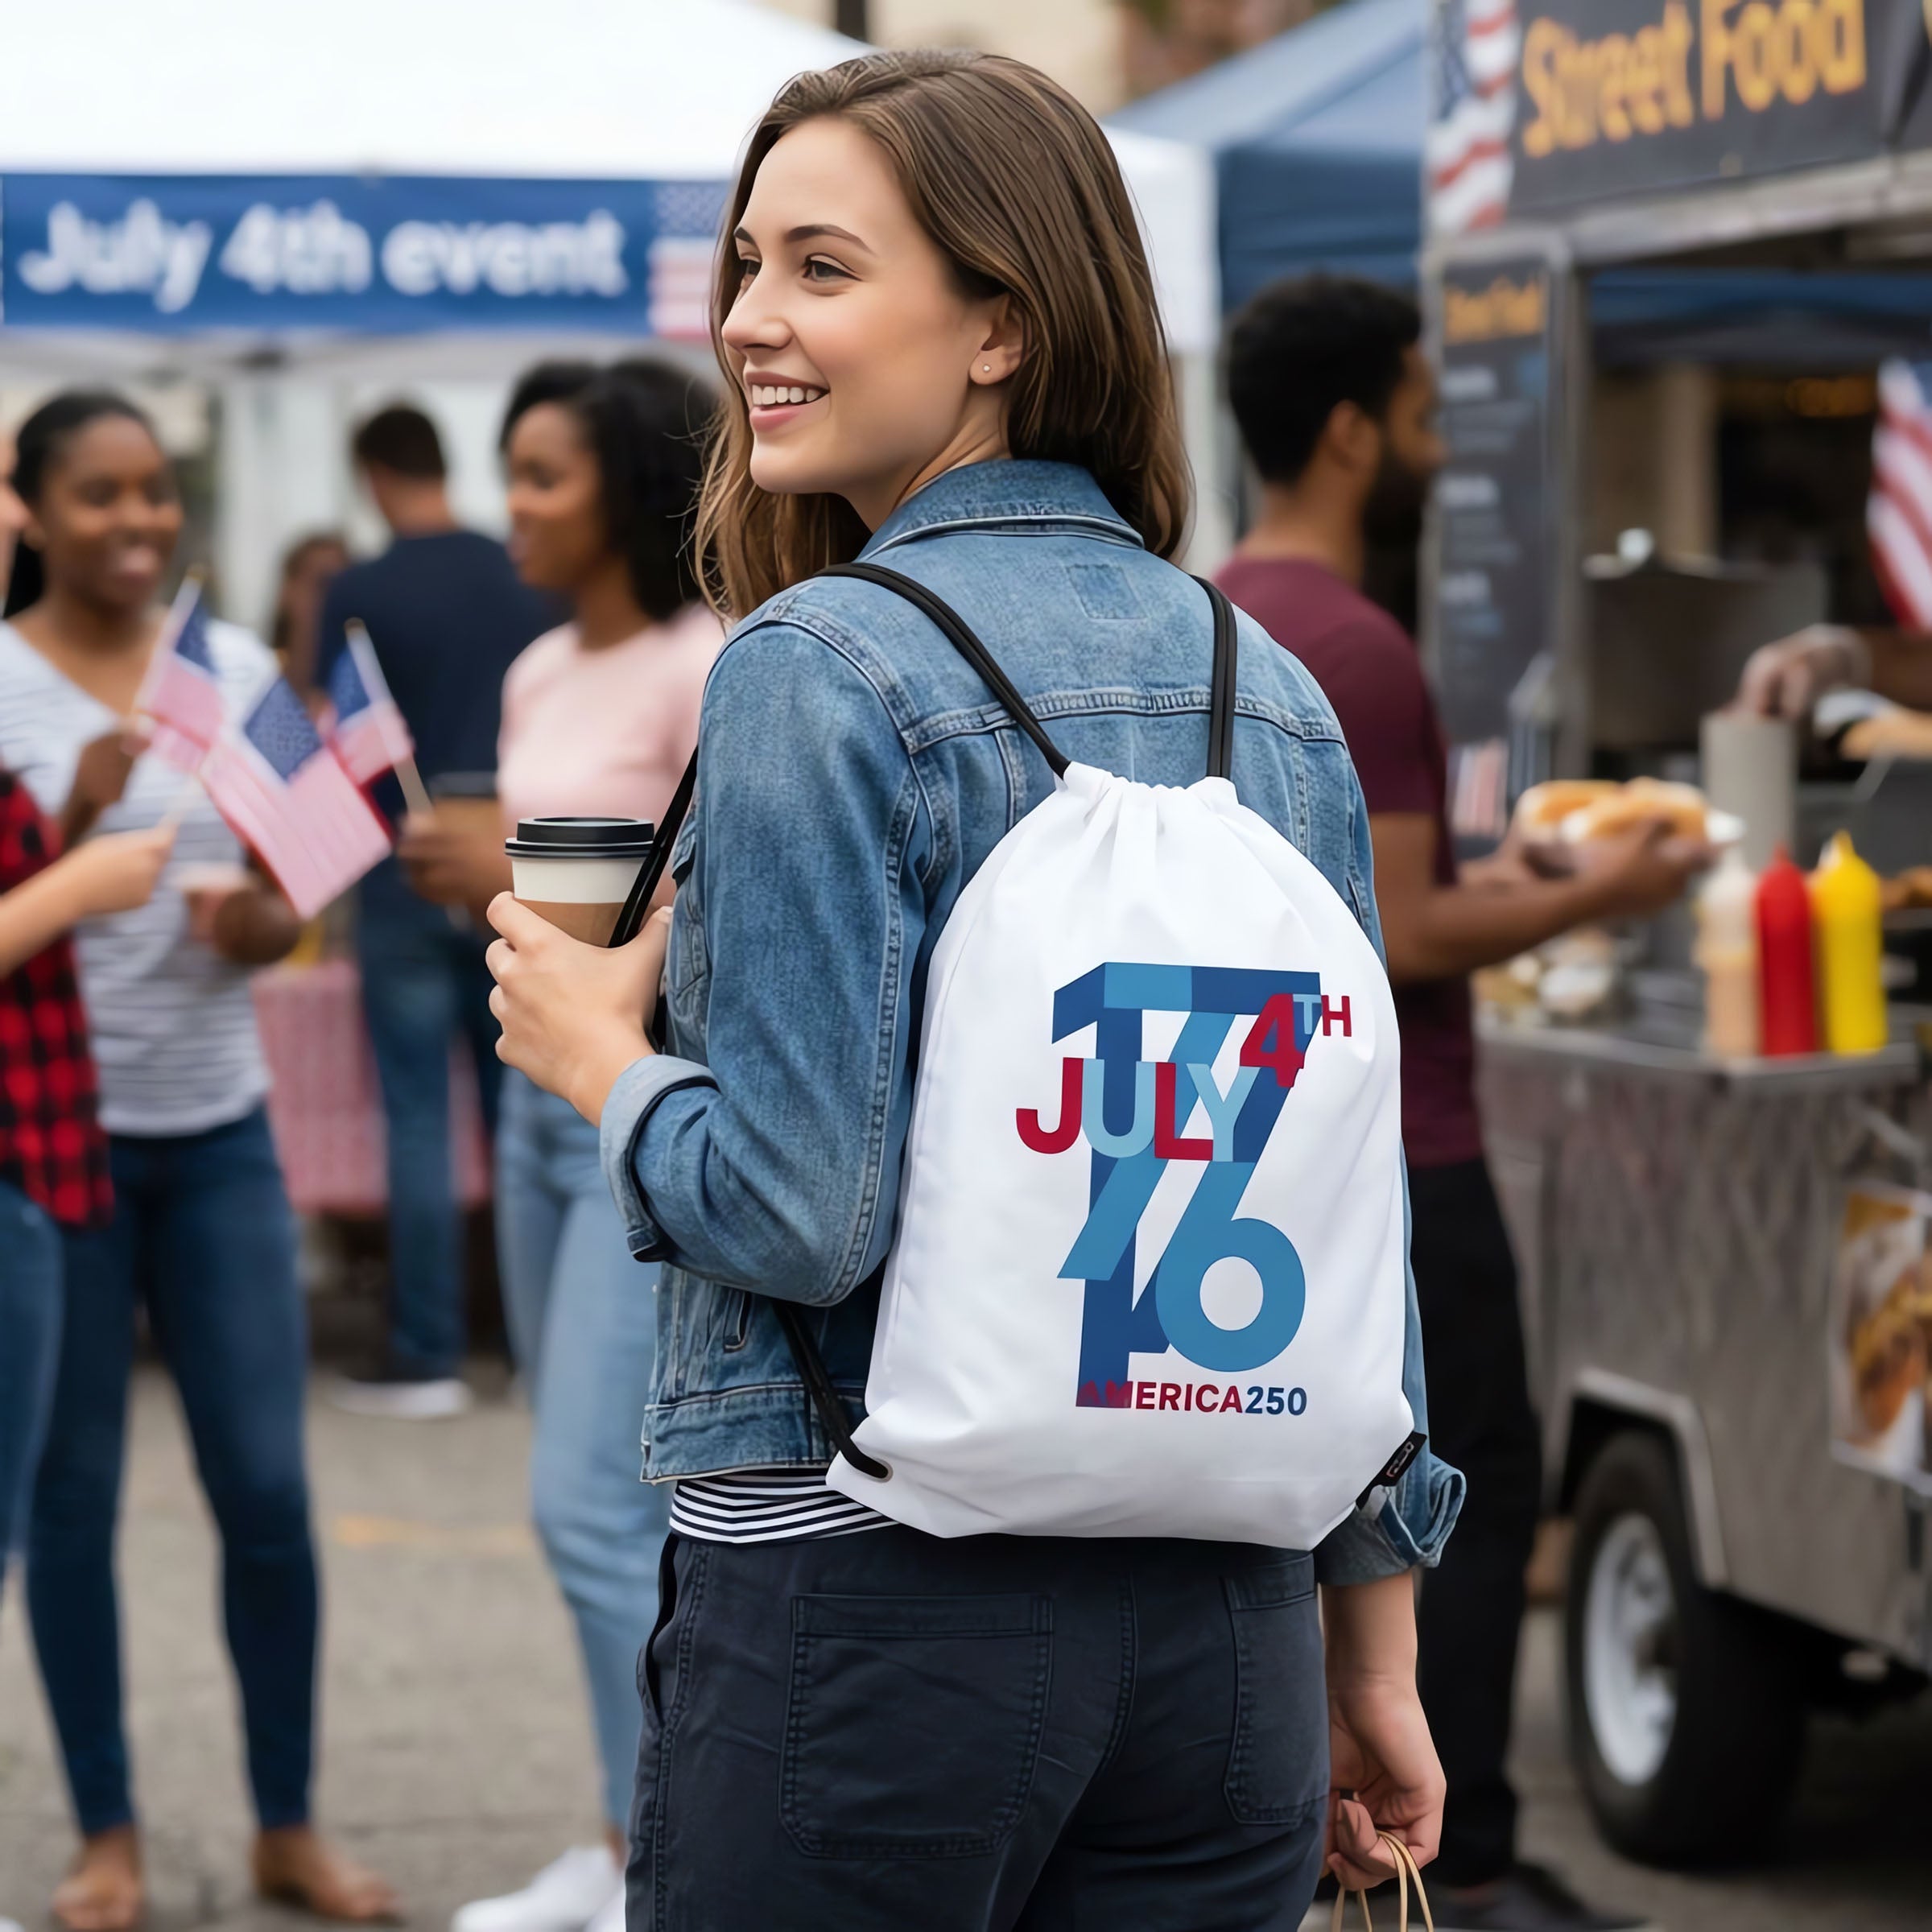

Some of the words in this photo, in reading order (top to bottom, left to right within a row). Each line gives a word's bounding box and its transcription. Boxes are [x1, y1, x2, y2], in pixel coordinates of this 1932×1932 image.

[1522, 0, 1692, 157] Street
[1701, 0, 1866, 121] Food
[17, 198, 213, 314] July
[220, 198, 374, 295] 4th
[381, 208, 630, 297] event
[1016, 1057, 1261, 1162] JULY
[1240, 993, 1352, 1088] 4TH
